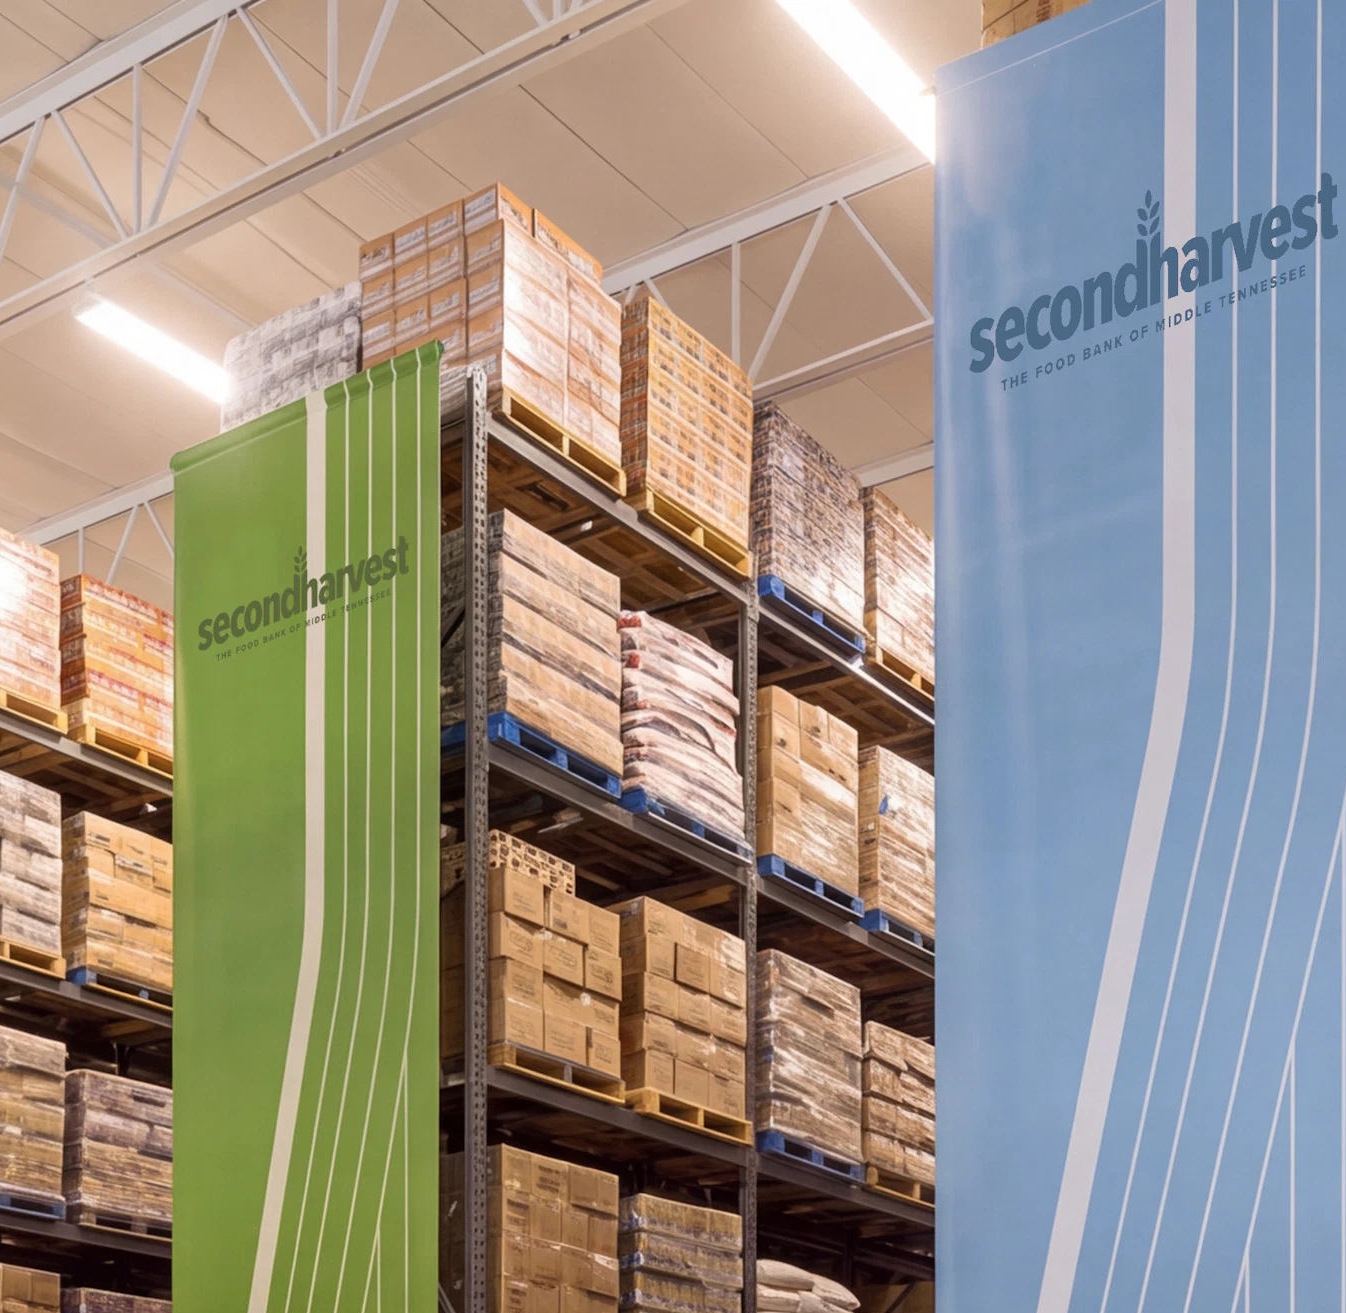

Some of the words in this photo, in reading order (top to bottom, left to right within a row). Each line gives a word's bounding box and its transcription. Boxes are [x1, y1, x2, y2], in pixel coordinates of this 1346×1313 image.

[969, 172, 1339, 373] secondharvest
[1000, 371, 1028, 391] THE
[1035, 353, 1076, 379] FOOD
[1083, 335, 1123, 361] BANK
[1129, 324, 1149, 342] OF
[1155, 301, 1212, 333] MIDDLE
[1219, 264, 1306, 308] TENNESSEE
[198, 535, 410, 651] secondharvest
[216, 650, 232, 661] THE
[235, 639, 259, 654] FOOD
[262, 629, 286, 644] BANK
[289, 622, 301, 633] OF
[304, 608, 337, 628] MIDDLE
[340, 588, 391, 613] TENNESSEE
